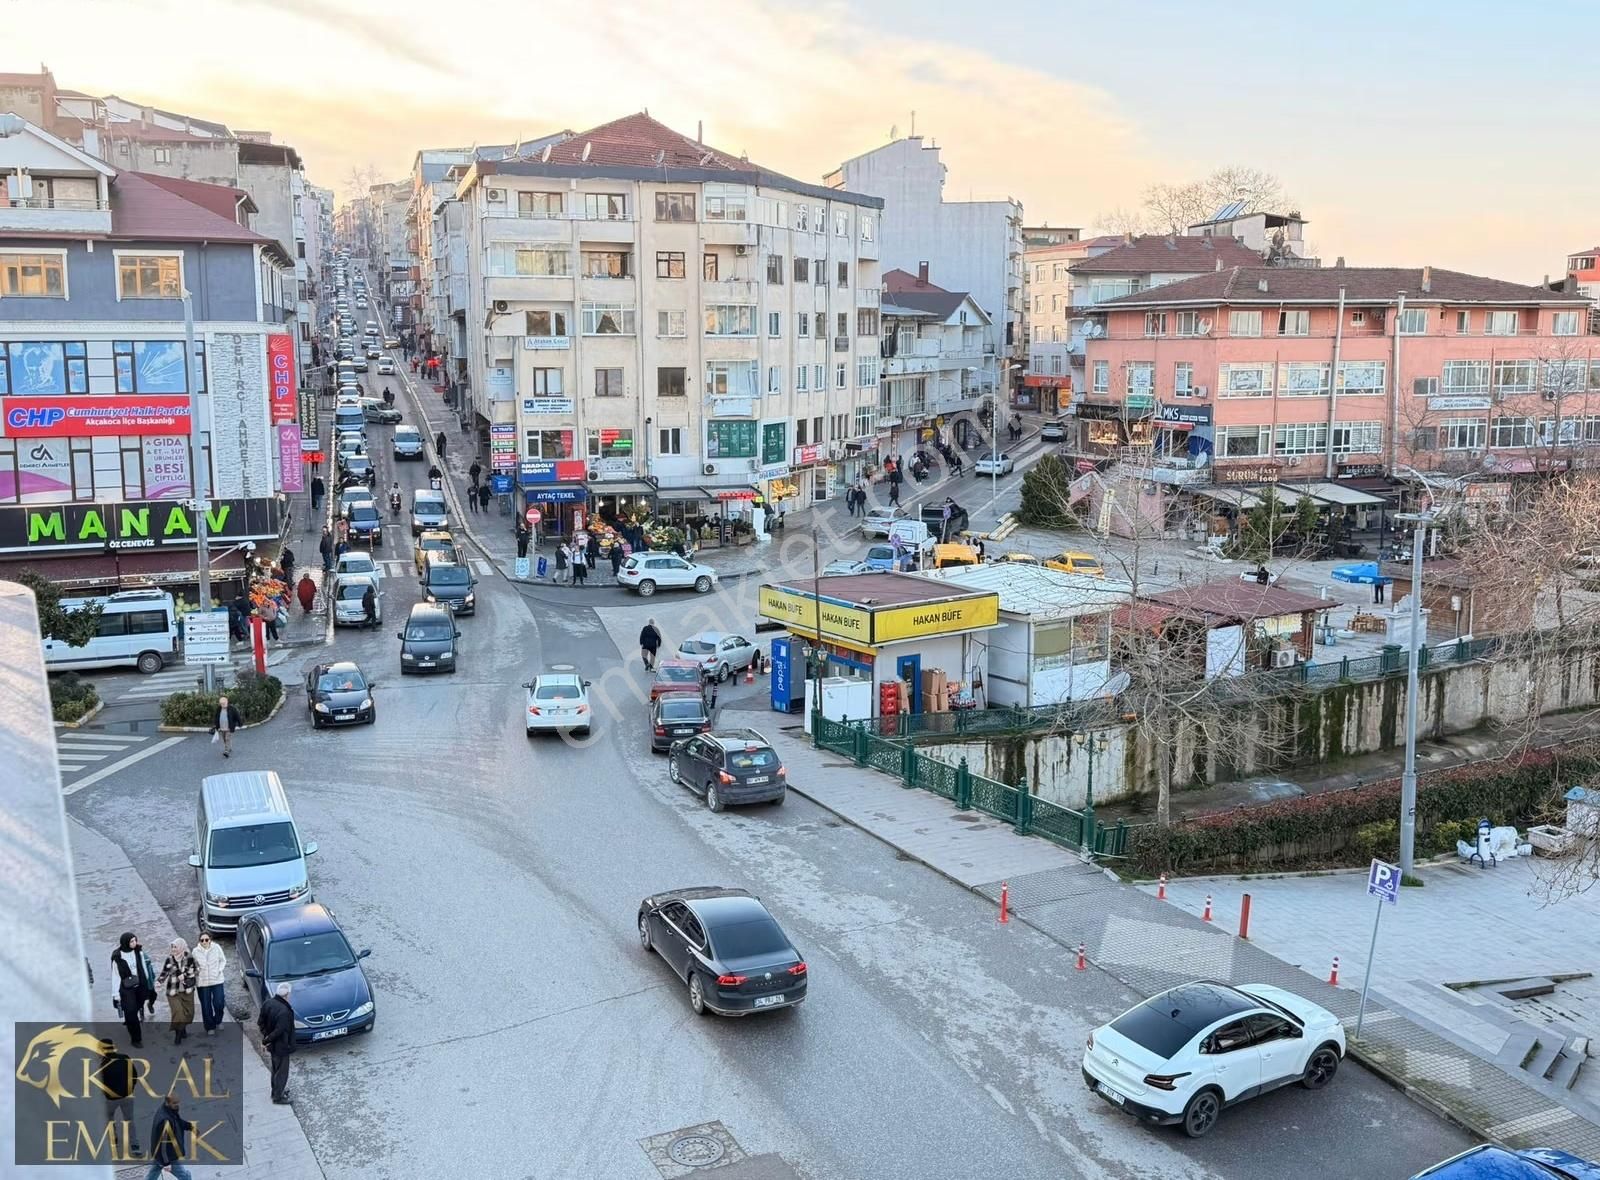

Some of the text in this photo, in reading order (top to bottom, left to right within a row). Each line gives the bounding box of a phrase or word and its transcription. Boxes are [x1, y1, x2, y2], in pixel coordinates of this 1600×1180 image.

[274, 354, 289, 400] CHP
[8, 407, 66, 428] CHP
[66, 405, 191, 418] Cumhuriyet Halk Partisi
[1163, 407, 1179, 420] MKS
[85, 416, 176, 426] Akçakoca İlçe Başkanlığı
[153, 438, 182, 446] GIDA
[239, 419, 252, 498] AHMETLER
[155, 460, 184, 473] BESİ
[28, 505, 230, 542] MANAV
[768, 598, 787, 611] HAKAN
[822, 611, 843, 626] HAKAN
[913, 609, 962, 626] HAKAN BÜFE
[777, 660, 786, 692] pepsi
